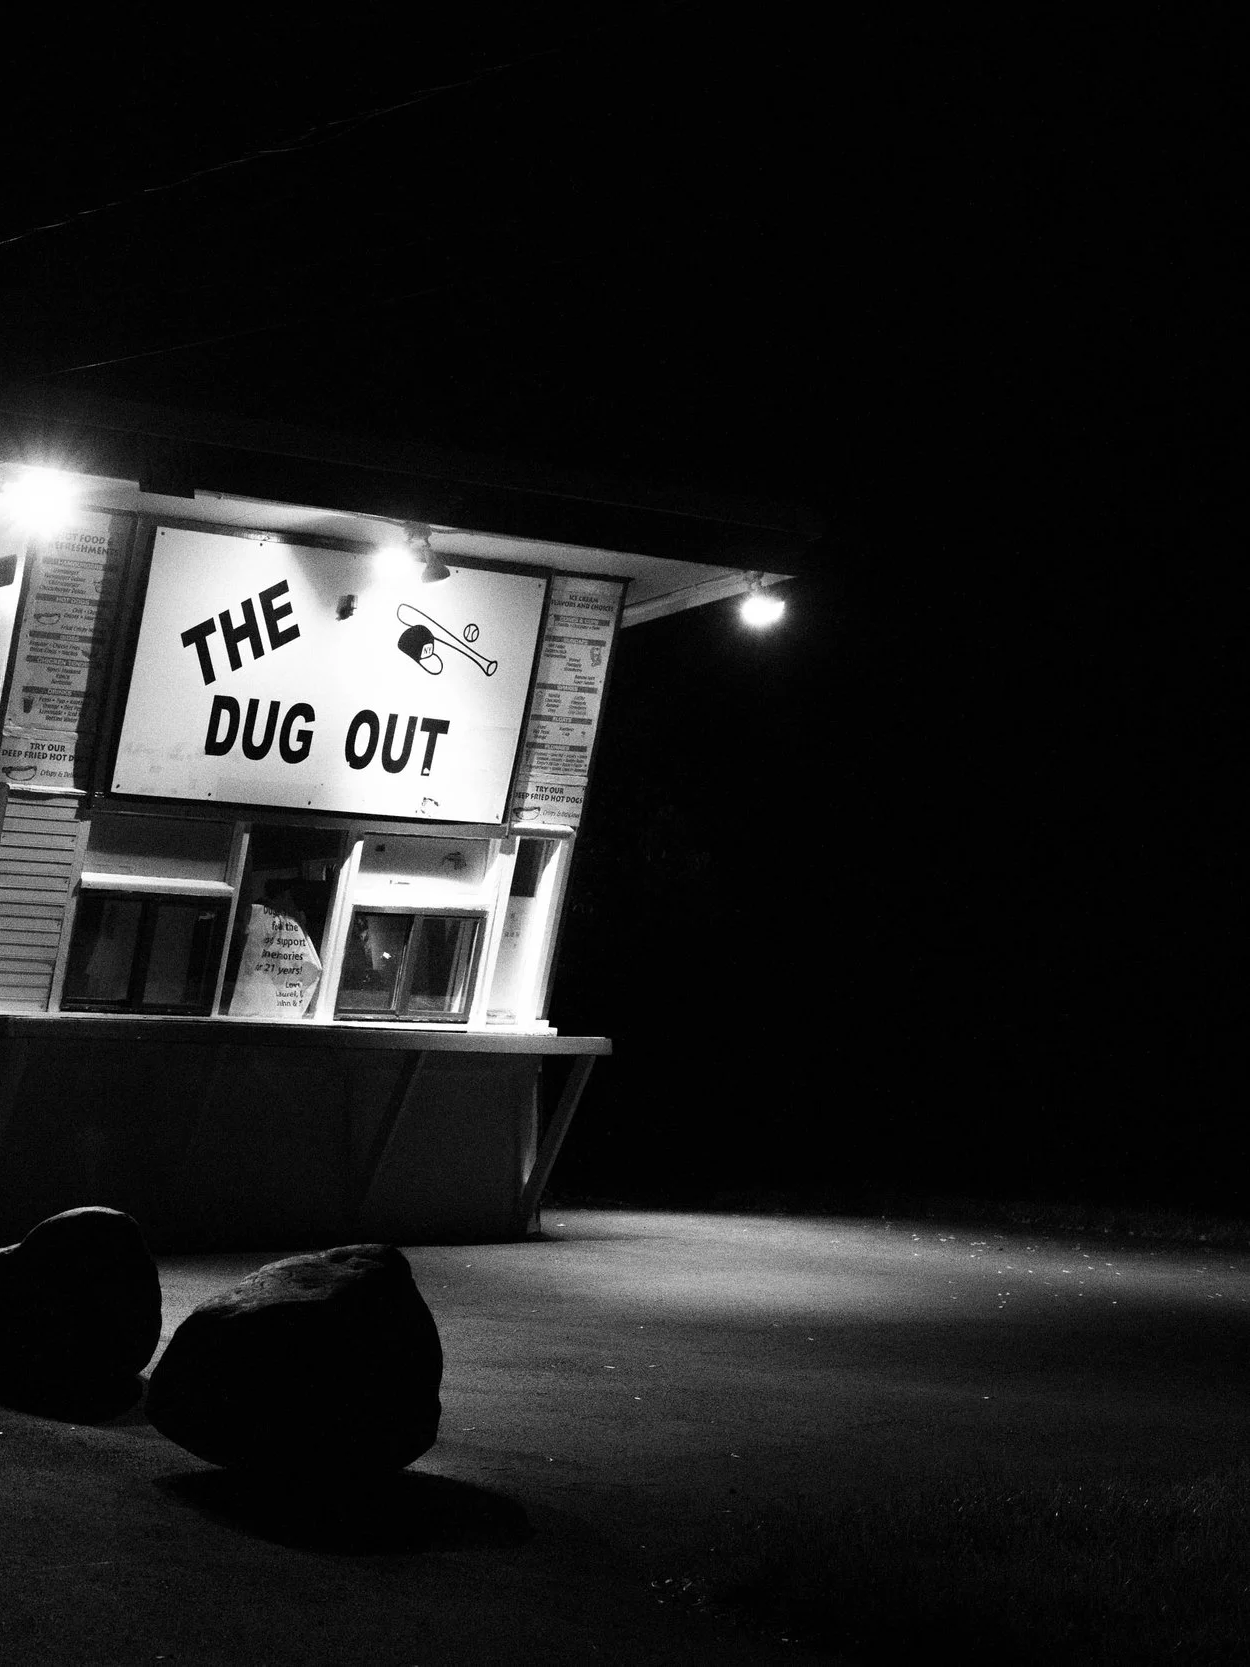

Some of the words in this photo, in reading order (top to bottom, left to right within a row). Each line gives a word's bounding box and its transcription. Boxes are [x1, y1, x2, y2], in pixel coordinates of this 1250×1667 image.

[80, 534, 106, 545] FOOD
[576, 602, 590, 610] AND
[180, 579, 301, 686] THE
[204, 694, 316, 764] DUG
[344, 708, 451, 777] OUT
[29, 742, 46, 751] TRY
[47, 743, 66, 753] OUR
[1, 749, 23, 758] DEEP
[24, 751, 48, 760] FRIED
[49, 753, 68, 762] HOT
[535, 785, 549, 793] TRY
[549, 786, 565, 795] OUR
[530, 793, 550, 802] FRIED
[550, 795, 566, 804] HOT
[566, 796, 583, 804] DOGS
[285, 921, 299, 932] the
[263, 962, 276, 973] 21
